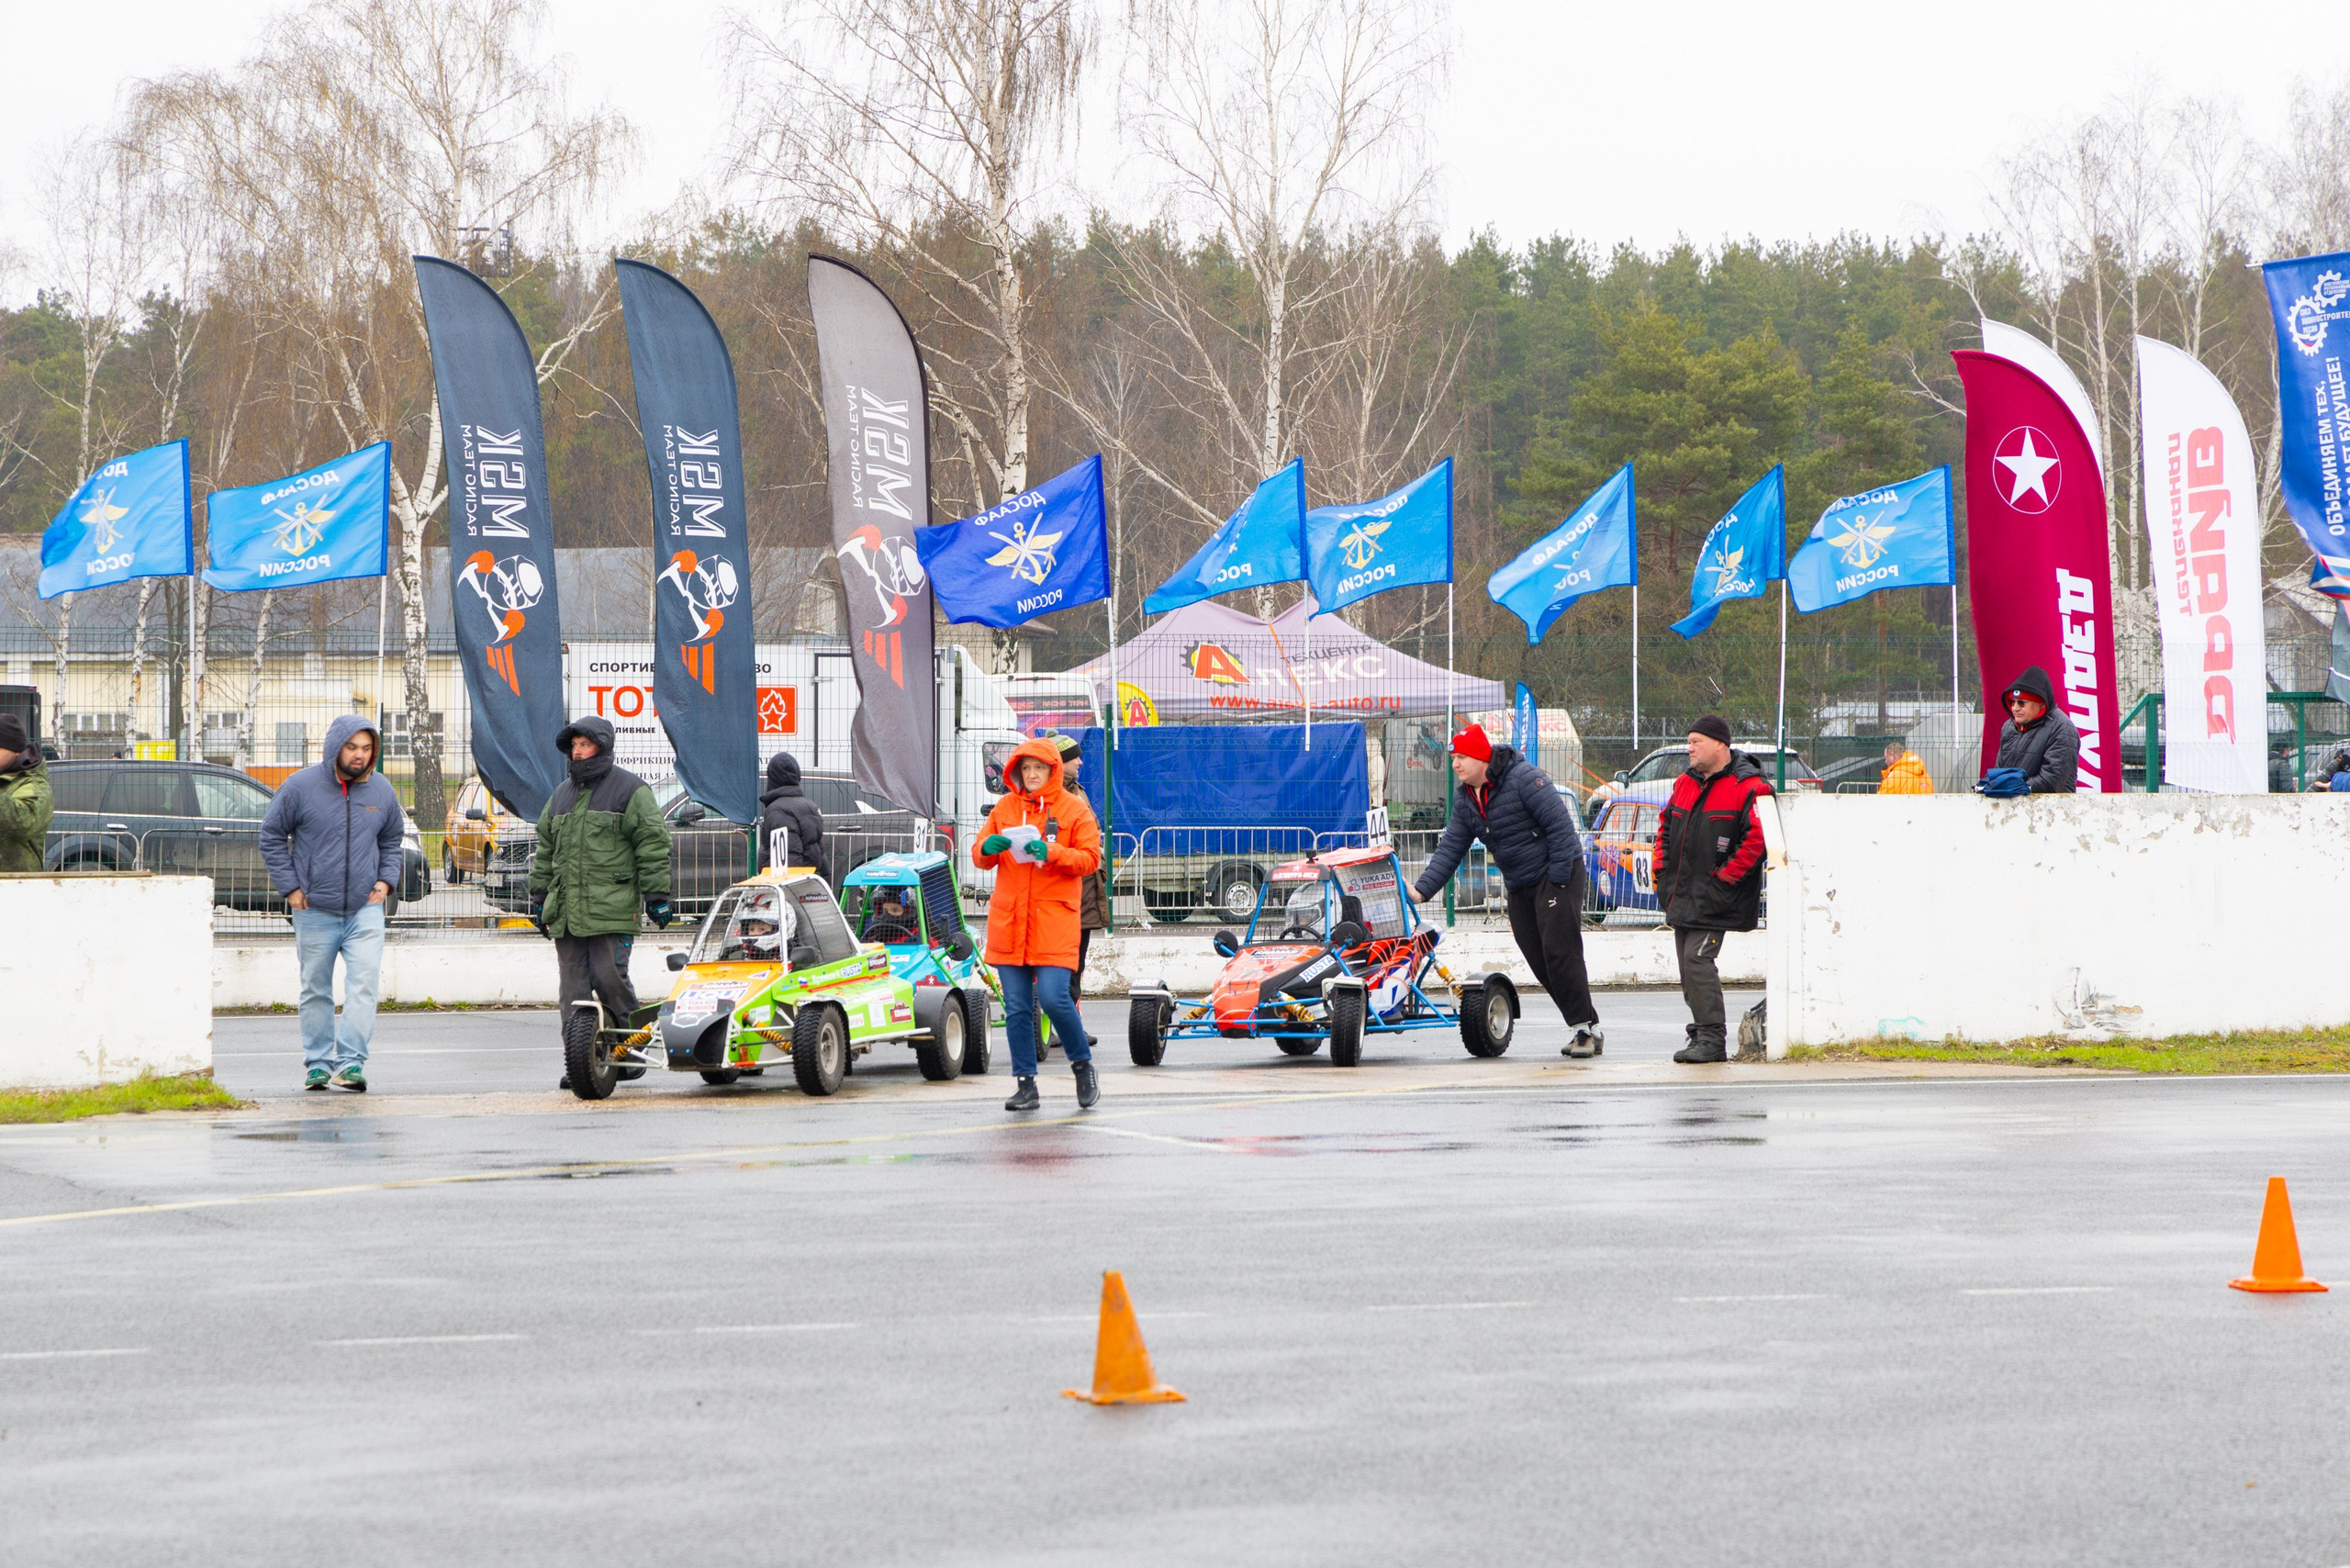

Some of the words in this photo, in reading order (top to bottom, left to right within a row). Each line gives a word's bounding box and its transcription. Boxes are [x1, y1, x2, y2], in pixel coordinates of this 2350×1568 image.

[2319, 419, 2346, 537] ОБЪЕДИНЯЕМ
[915, 825, 926, 849] 31
[1370, 811, 1387, 846] 44
[773, 830, 787, 868] 10
[1360, 875, 1380, 883] YUKA
[1636, 857, 1650, 888] 83
[842, 963, 861, 978] RUSTA
[1303, 956, 1336, 981] RUSTA
